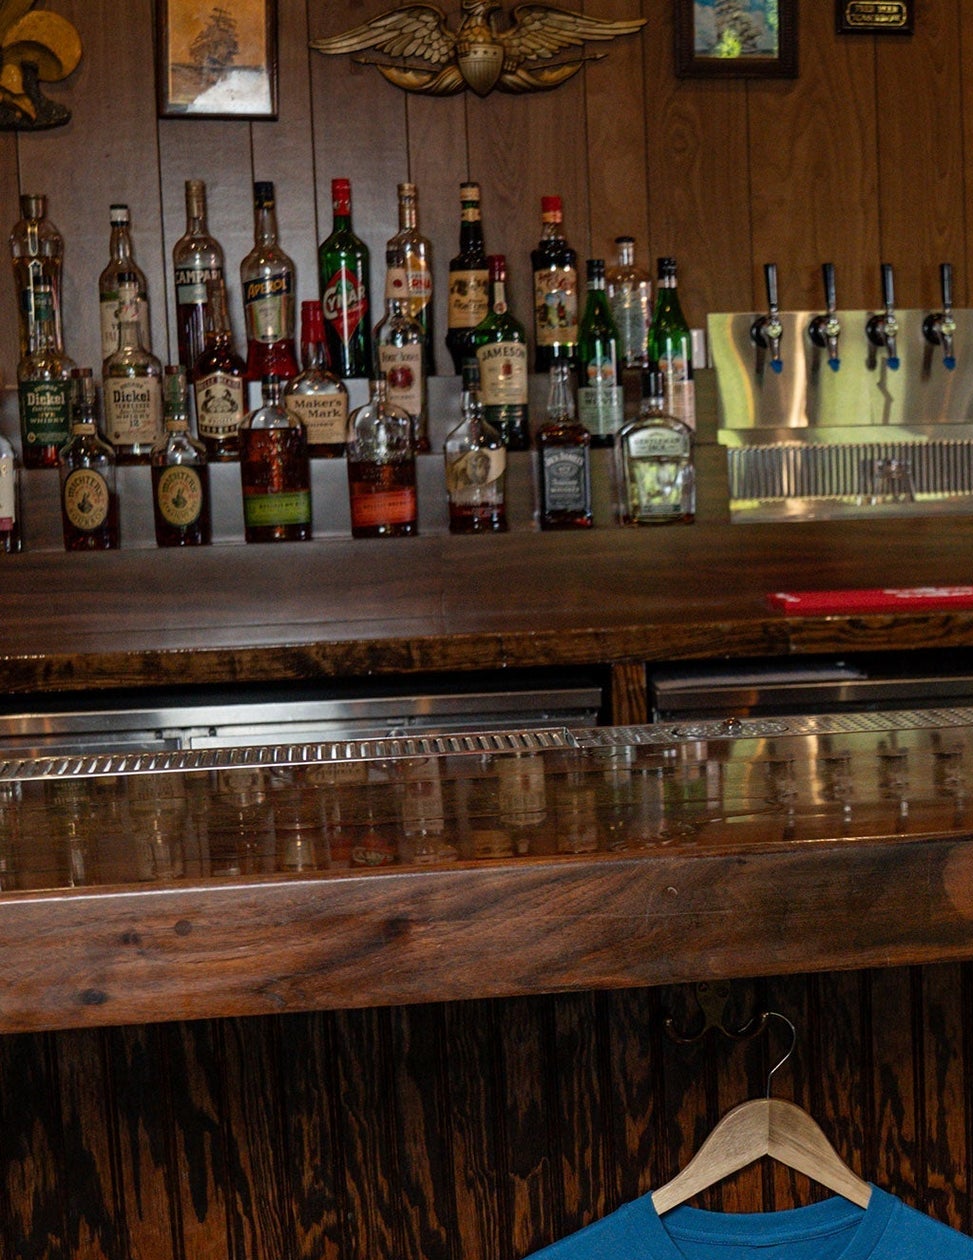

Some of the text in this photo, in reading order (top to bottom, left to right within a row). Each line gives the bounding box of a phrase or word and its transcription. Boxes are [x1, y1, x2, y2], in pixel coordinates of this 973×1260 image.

[27, 391, 66, 406] Dickel
[112, 389, 150, 403] Dickel
[294, 398, 343, 409] Maker's
